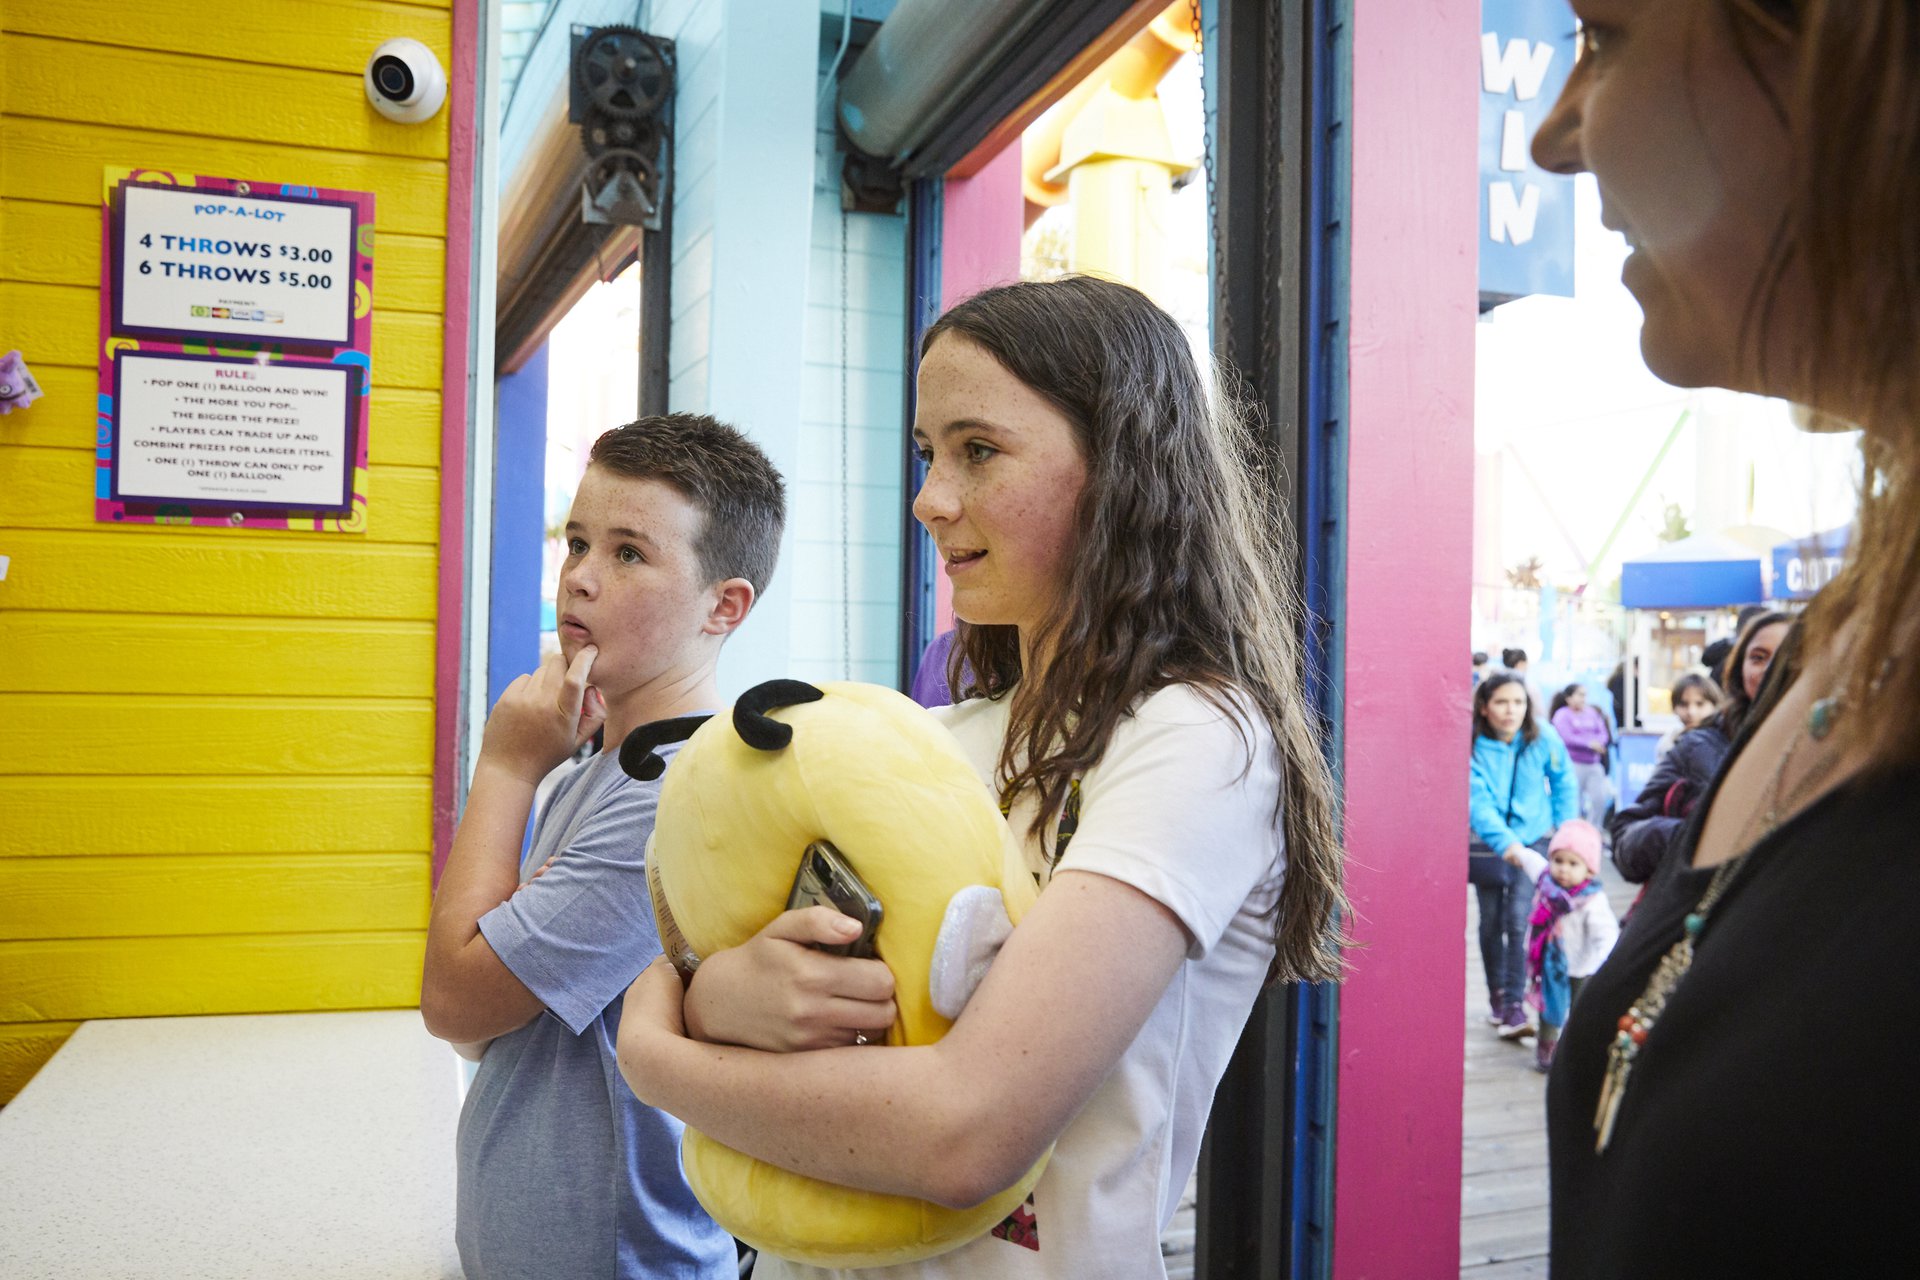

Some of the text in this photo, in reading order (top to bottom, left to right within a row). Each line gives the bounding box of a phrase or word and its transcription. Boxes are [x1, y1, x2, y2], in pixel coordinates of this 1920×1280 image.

[1481, 32, 1554, 246] WIN
[194, 204, 286, 222] POP-A-LOT
[139, 233, 332, 263] 4 THROWS $3.00
[139, 260, 332, 289] 6 THROWS $5.00
[215, 369, 256, 380] RULE
[151, 379, 174, 388] POP
[177, 381, 199, 389] ONE
[220, 384, 272, 394] BALLOON
[275, 388, 299, 396] AND
[302, 389, 329, 397] WIN!
[183, 396, 206, 404] THE
[209, 398, 240, 406] MORE
[243, 400, 266, 408] YOU
[172, 411, 194, 419] THE
[197, 413, 239, 422] BIGGER
[241, 415, 263, 423] THE
[159, 426, 206, 436] PLAYERS
[210, 429, 233, 437] CAN
[237, 431, 273, 439] TRADE
[134, 440, 186, 450] COMBINE
[189, 443, 226, 452] PRIZES
[230, 445, 251, 453] FOR
[254, 447, 296, 456] LARGER
[155, 457, 178, 466] ONE
[199, 459, 242, 469] THROW
[246, 462, 270, 470] CAN
[272, 463, 299, 471] ONLY
[187, 470, 210, 478] ONE
[1786, 557, 1843, 592] COT
